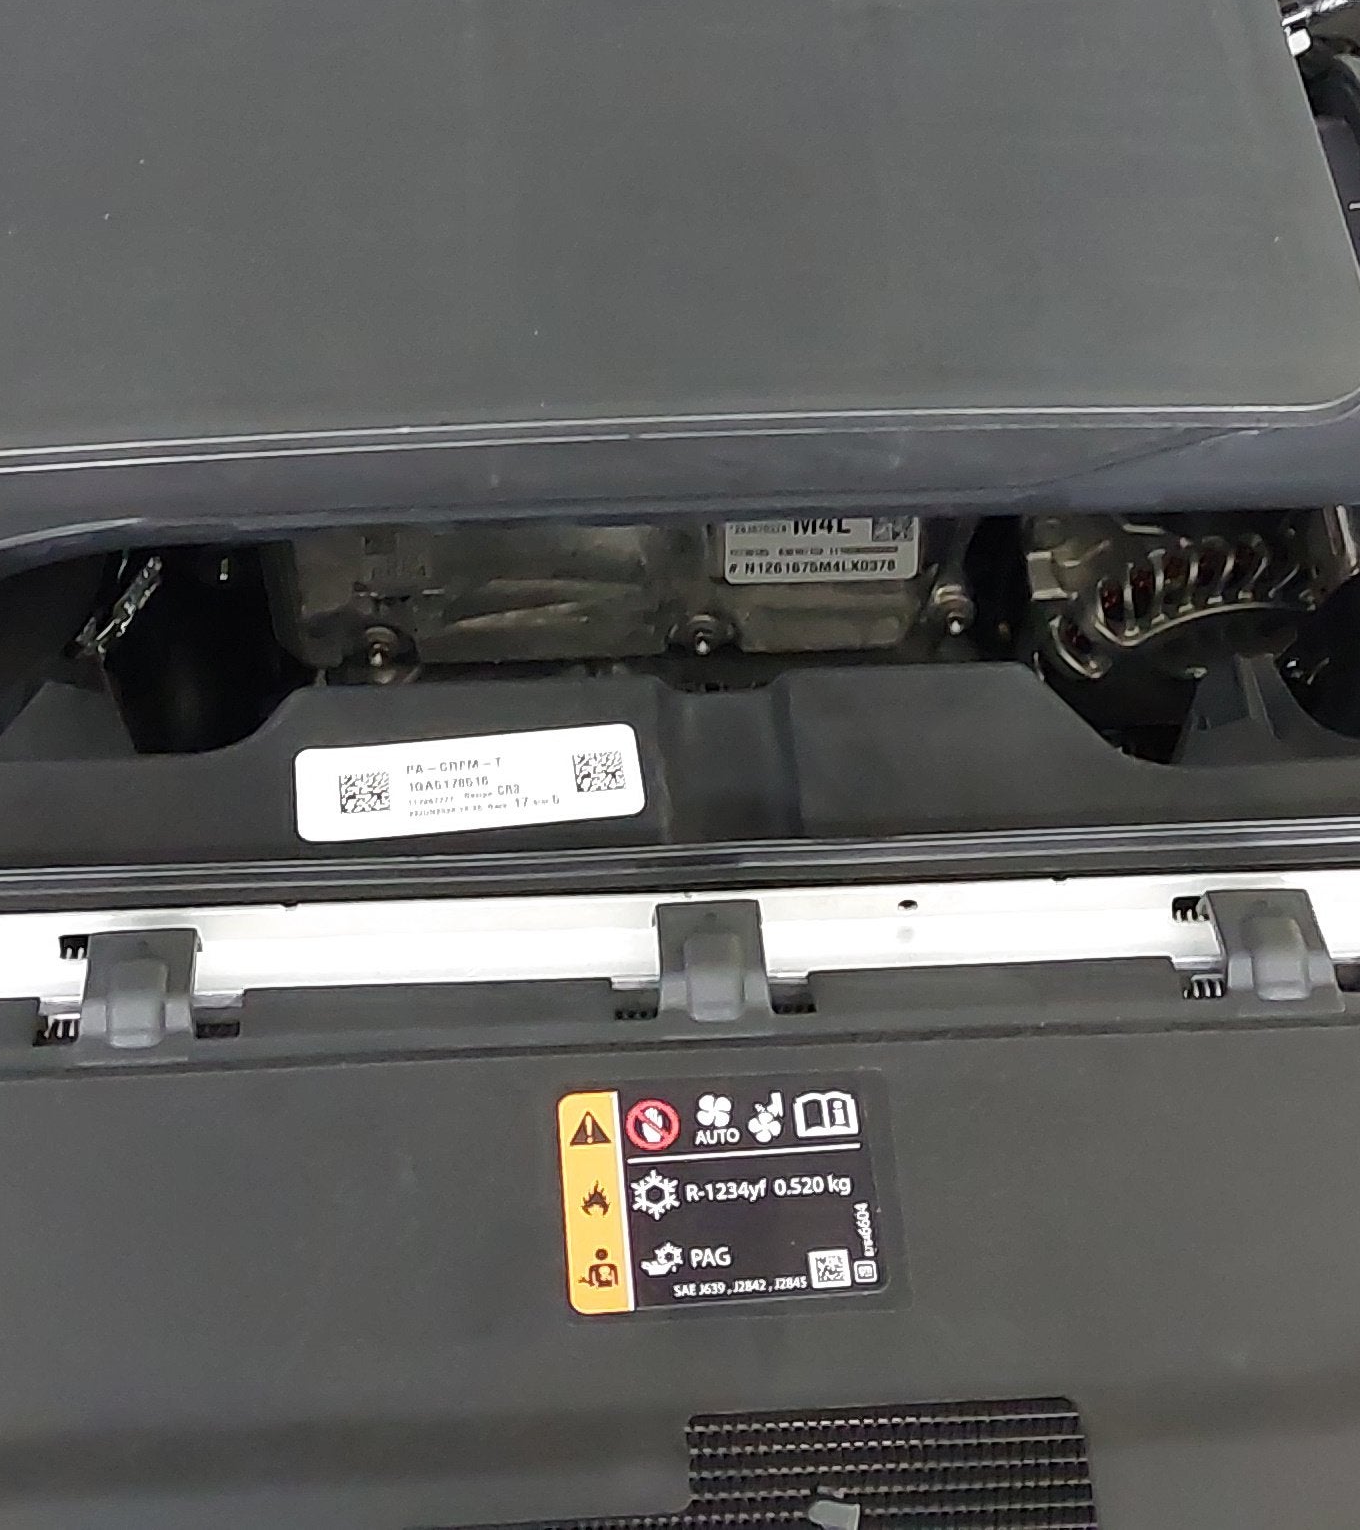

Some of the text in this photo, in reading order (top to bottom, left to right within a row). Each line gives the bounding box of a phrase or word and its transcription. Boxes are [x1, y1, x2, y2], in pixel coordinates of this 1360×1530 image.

[695, 1128, 740, 1145] AUTO
[686, 1175, 851, 1201] R-1234yf 0.520 kg
[691, 1247, 730, 1267] PAG
[674, 1284, 696, 1297] SAE
